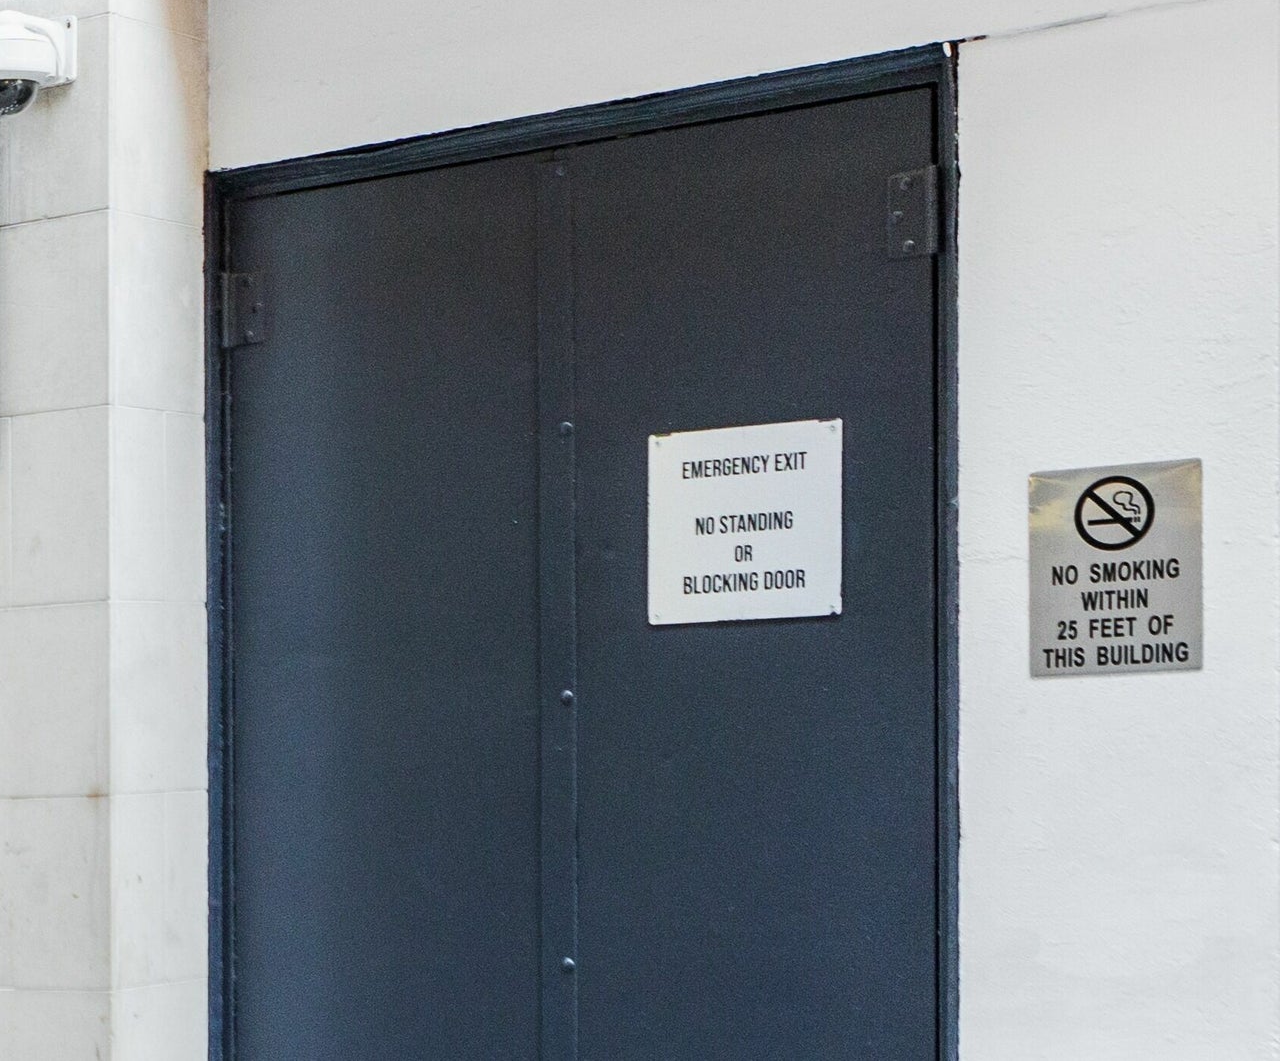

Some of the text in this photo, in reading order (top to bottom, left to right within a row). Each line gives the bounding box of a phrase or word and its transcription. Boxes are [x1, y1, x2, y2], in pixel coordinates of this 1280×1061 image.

[682, 451, 807, 480] EMERGENCY EXIT
[695, 510, 793, 535] NO STANDING
[734, 544, 753, 563] OR
[683, 569, 806, 595] BLOCKING DOOR
[1051, 557, 1180, 586] NO SMOKING
[1080, 587, 1149, 612] WITHIN
[1057, 614, 1175, 641] 25 FEET OF
[1042, 641, 1189, 669] THIS BUILDING
